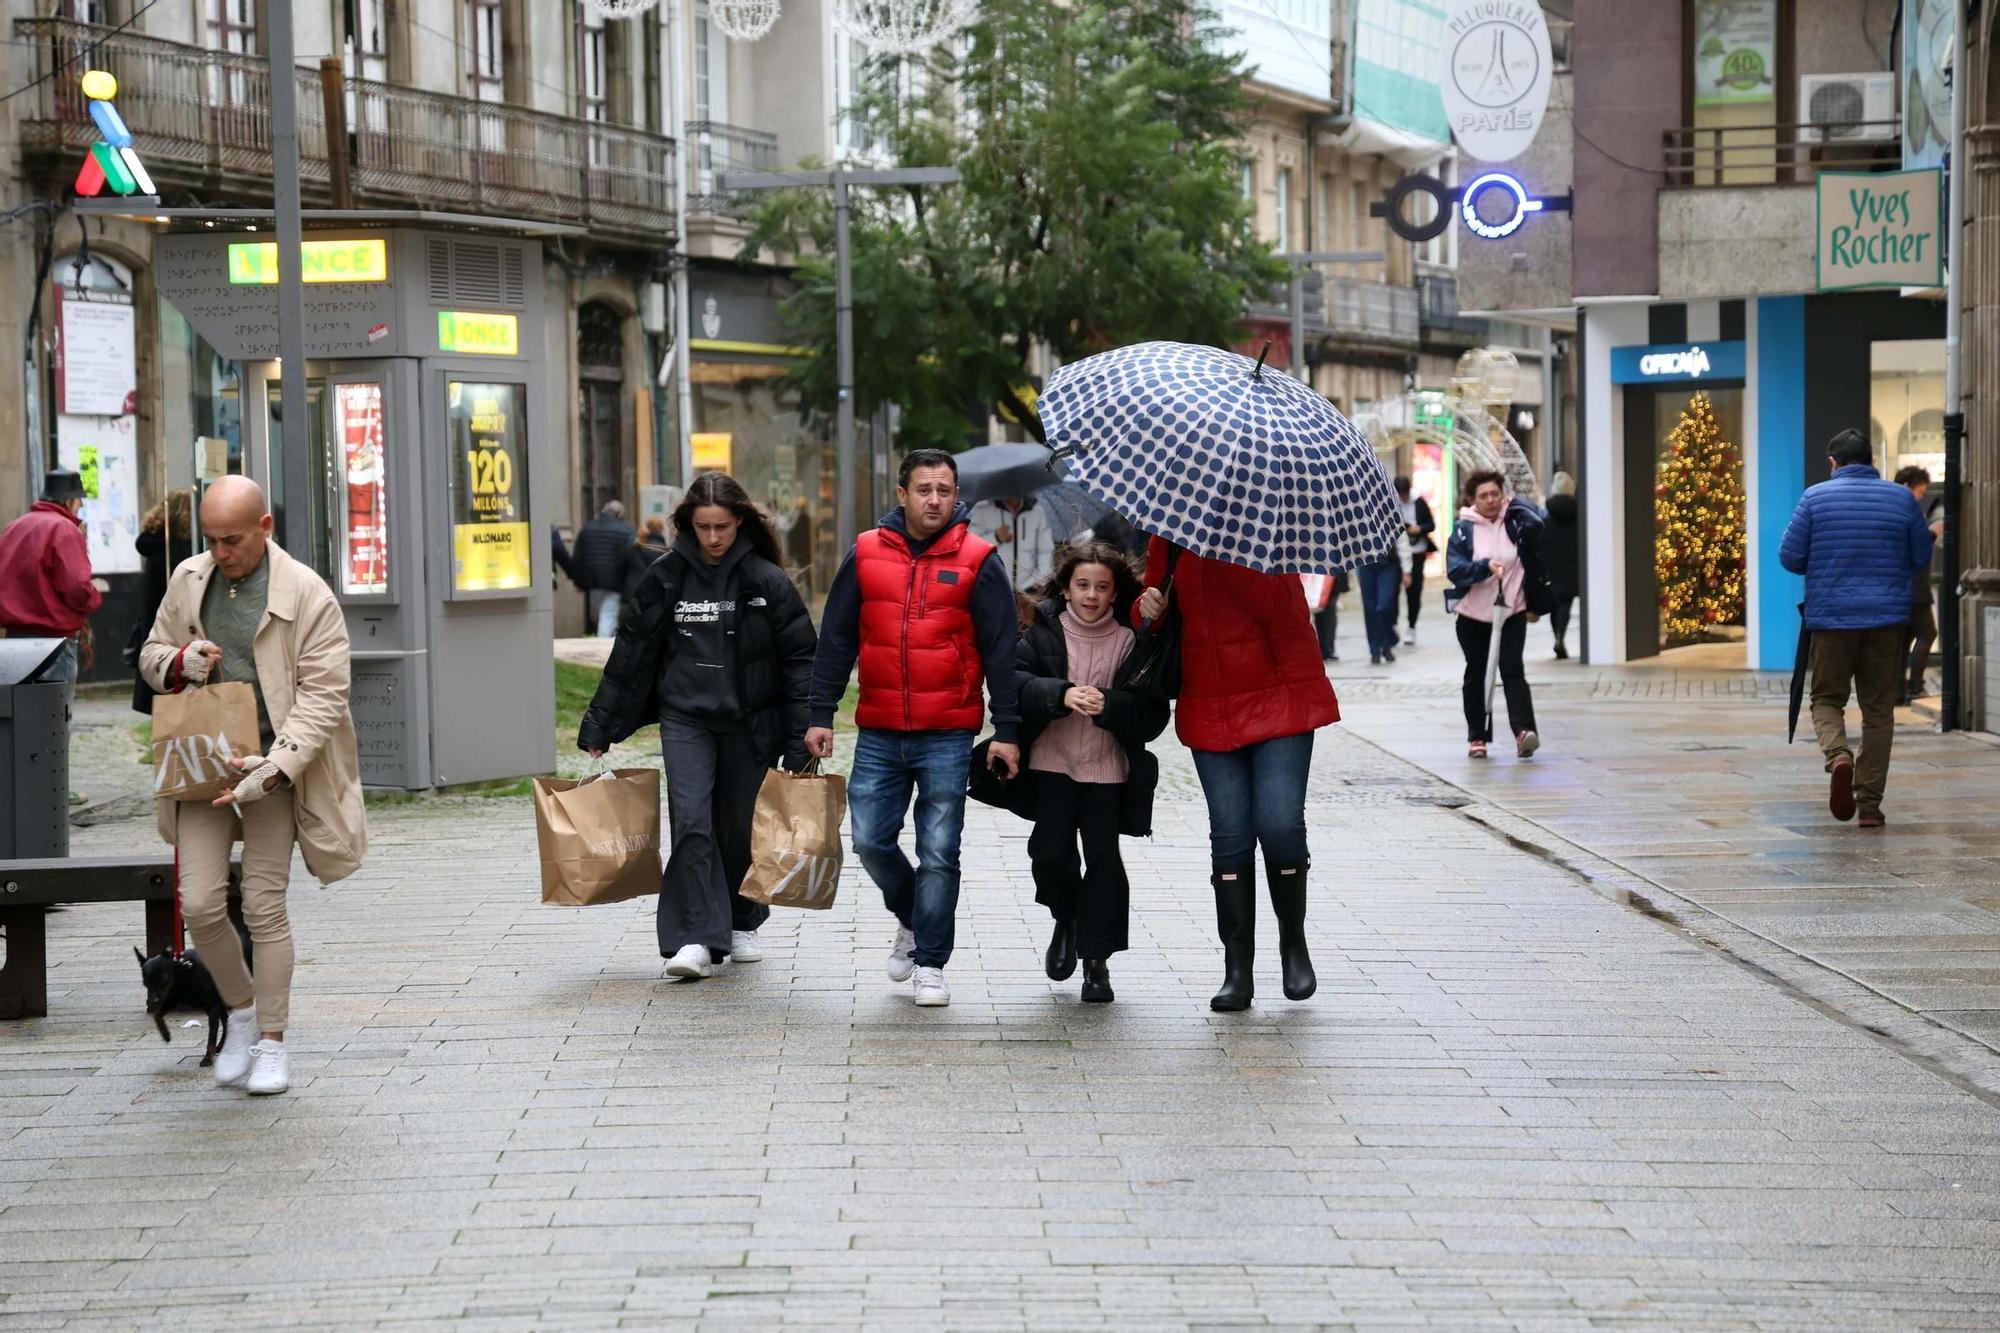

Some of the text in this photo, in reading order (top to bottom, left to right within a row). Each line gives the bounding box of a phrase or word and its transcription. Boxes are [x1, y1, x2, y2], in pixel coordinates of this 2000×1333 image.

[1849, 188, 1910, 230] Yves
[303, 247, 370, 273] NCE
[1831, 225, 1931, 269] Rocher
[461, 321, 508, 346] ONCE
[467, 449, 512, 494] 120
[674, 600, 719, 615] Chasing
[768, 850, 838, 900] ZAR
